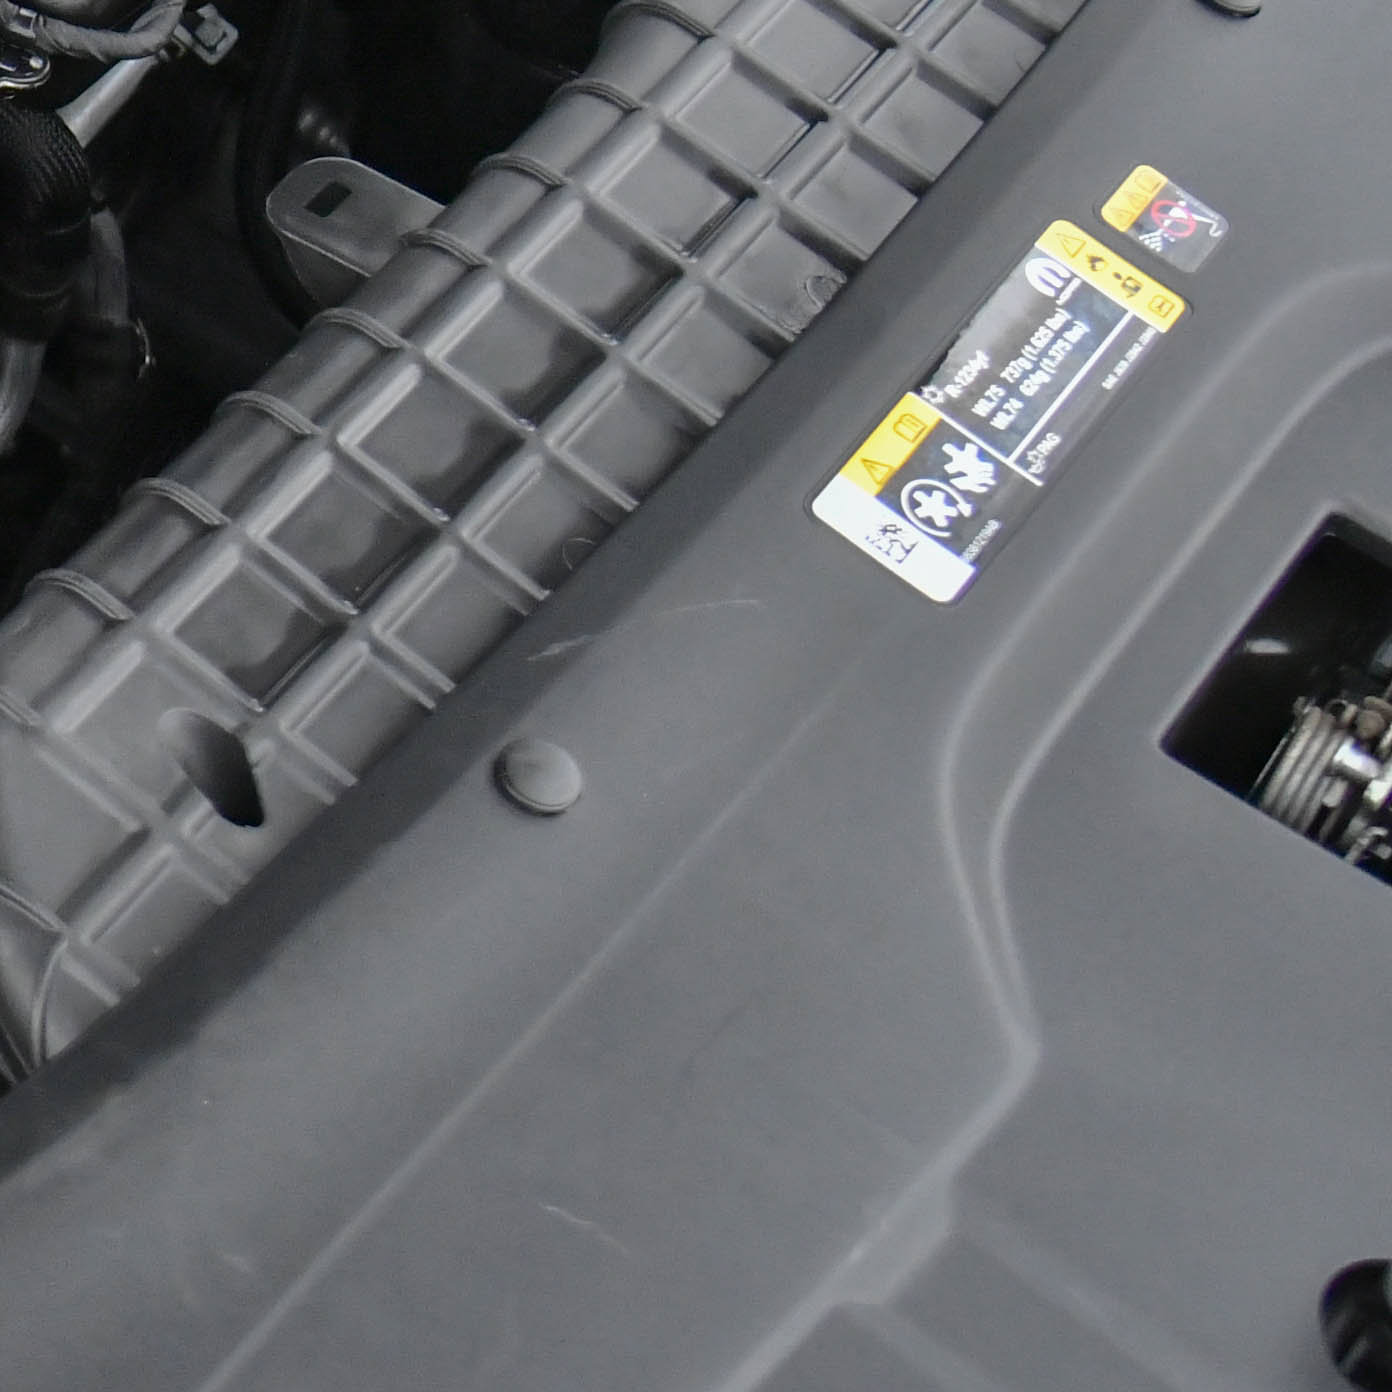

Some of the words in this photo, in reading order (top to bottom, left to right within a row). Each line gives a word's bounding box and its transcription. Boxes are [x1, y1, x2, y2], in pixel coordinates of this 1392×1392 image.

[943, 349, 991, 398] R-1234yf
[971, 385, 1006, 418] WL75
[989, 397, 1024, 430] WL74
[1036, 431, 1062, 455] PAG
